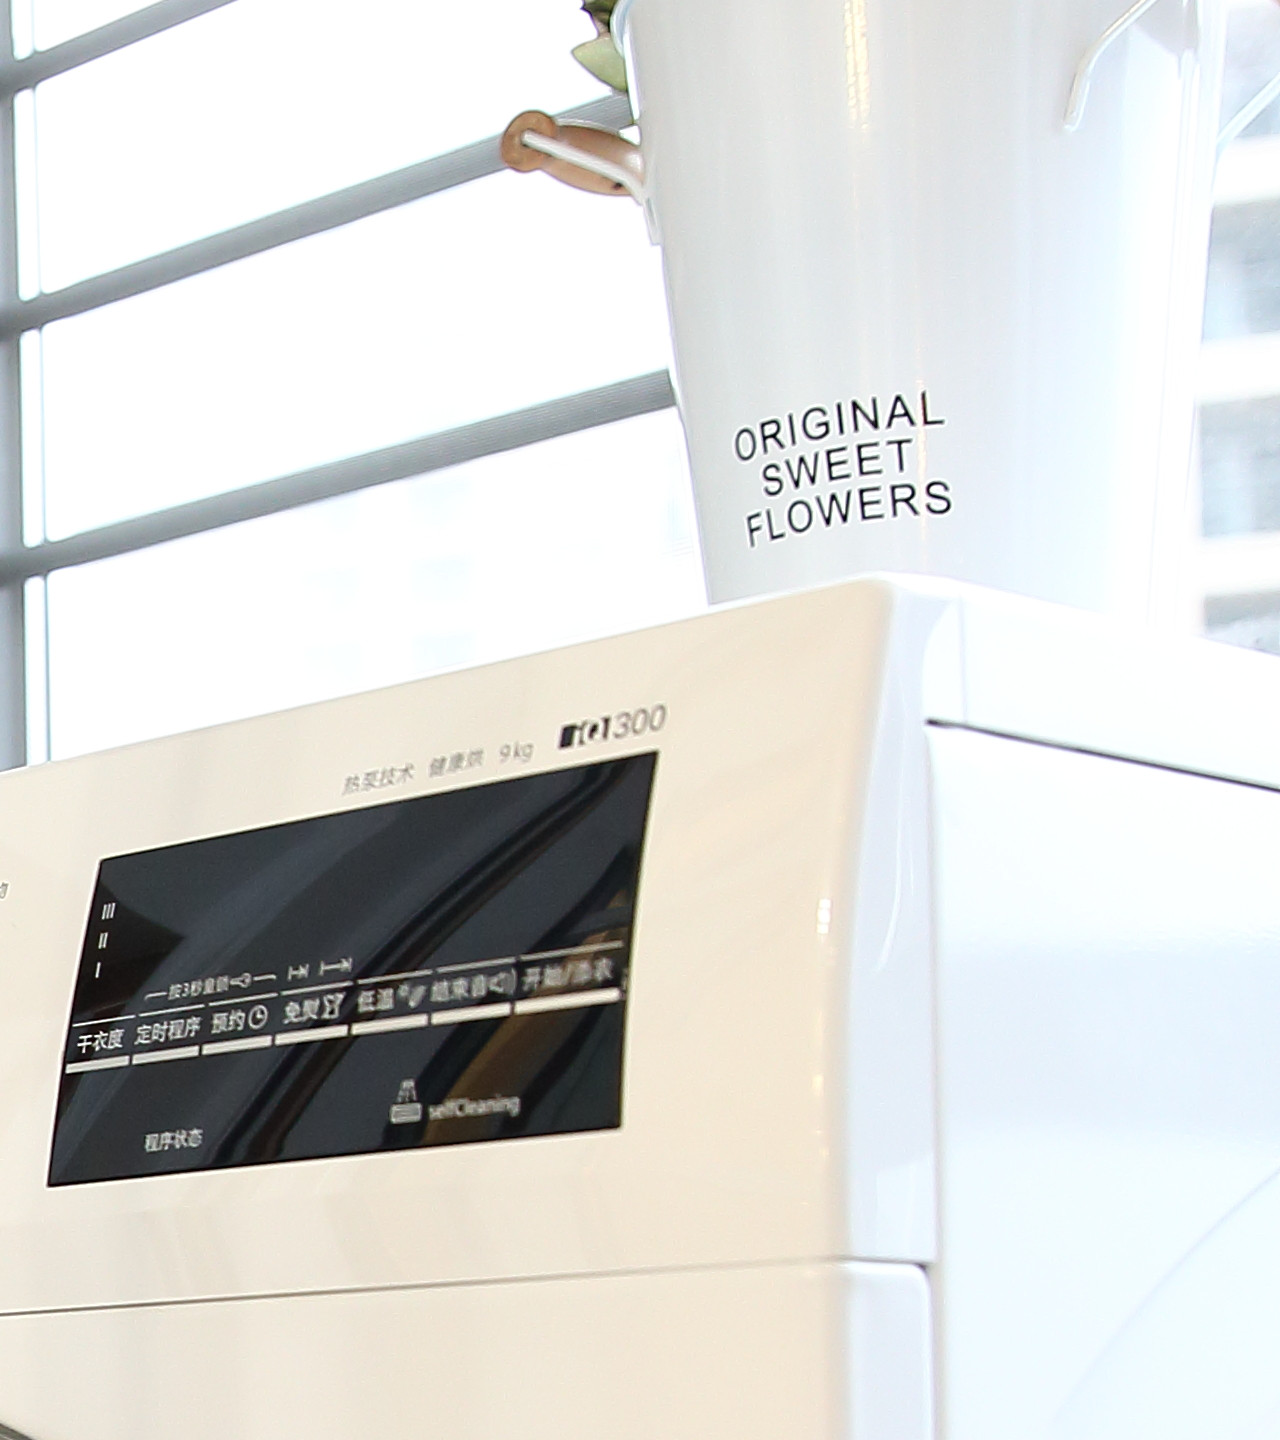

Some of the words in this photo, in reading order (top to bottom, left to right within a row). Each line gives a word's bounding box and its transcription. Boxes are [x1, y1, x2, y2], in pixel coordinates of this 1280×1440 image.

[735, 390, 945, 461] ORIGINAL
[762, 438, 914, 496] SWEET
[746, 481, 952, 547] FLOWERS
[77, 1029, 123, 1054] 干衣度
[134, 1017, 201, 1045] 定时程序
[211, 1010, 245, 1034] 预约
